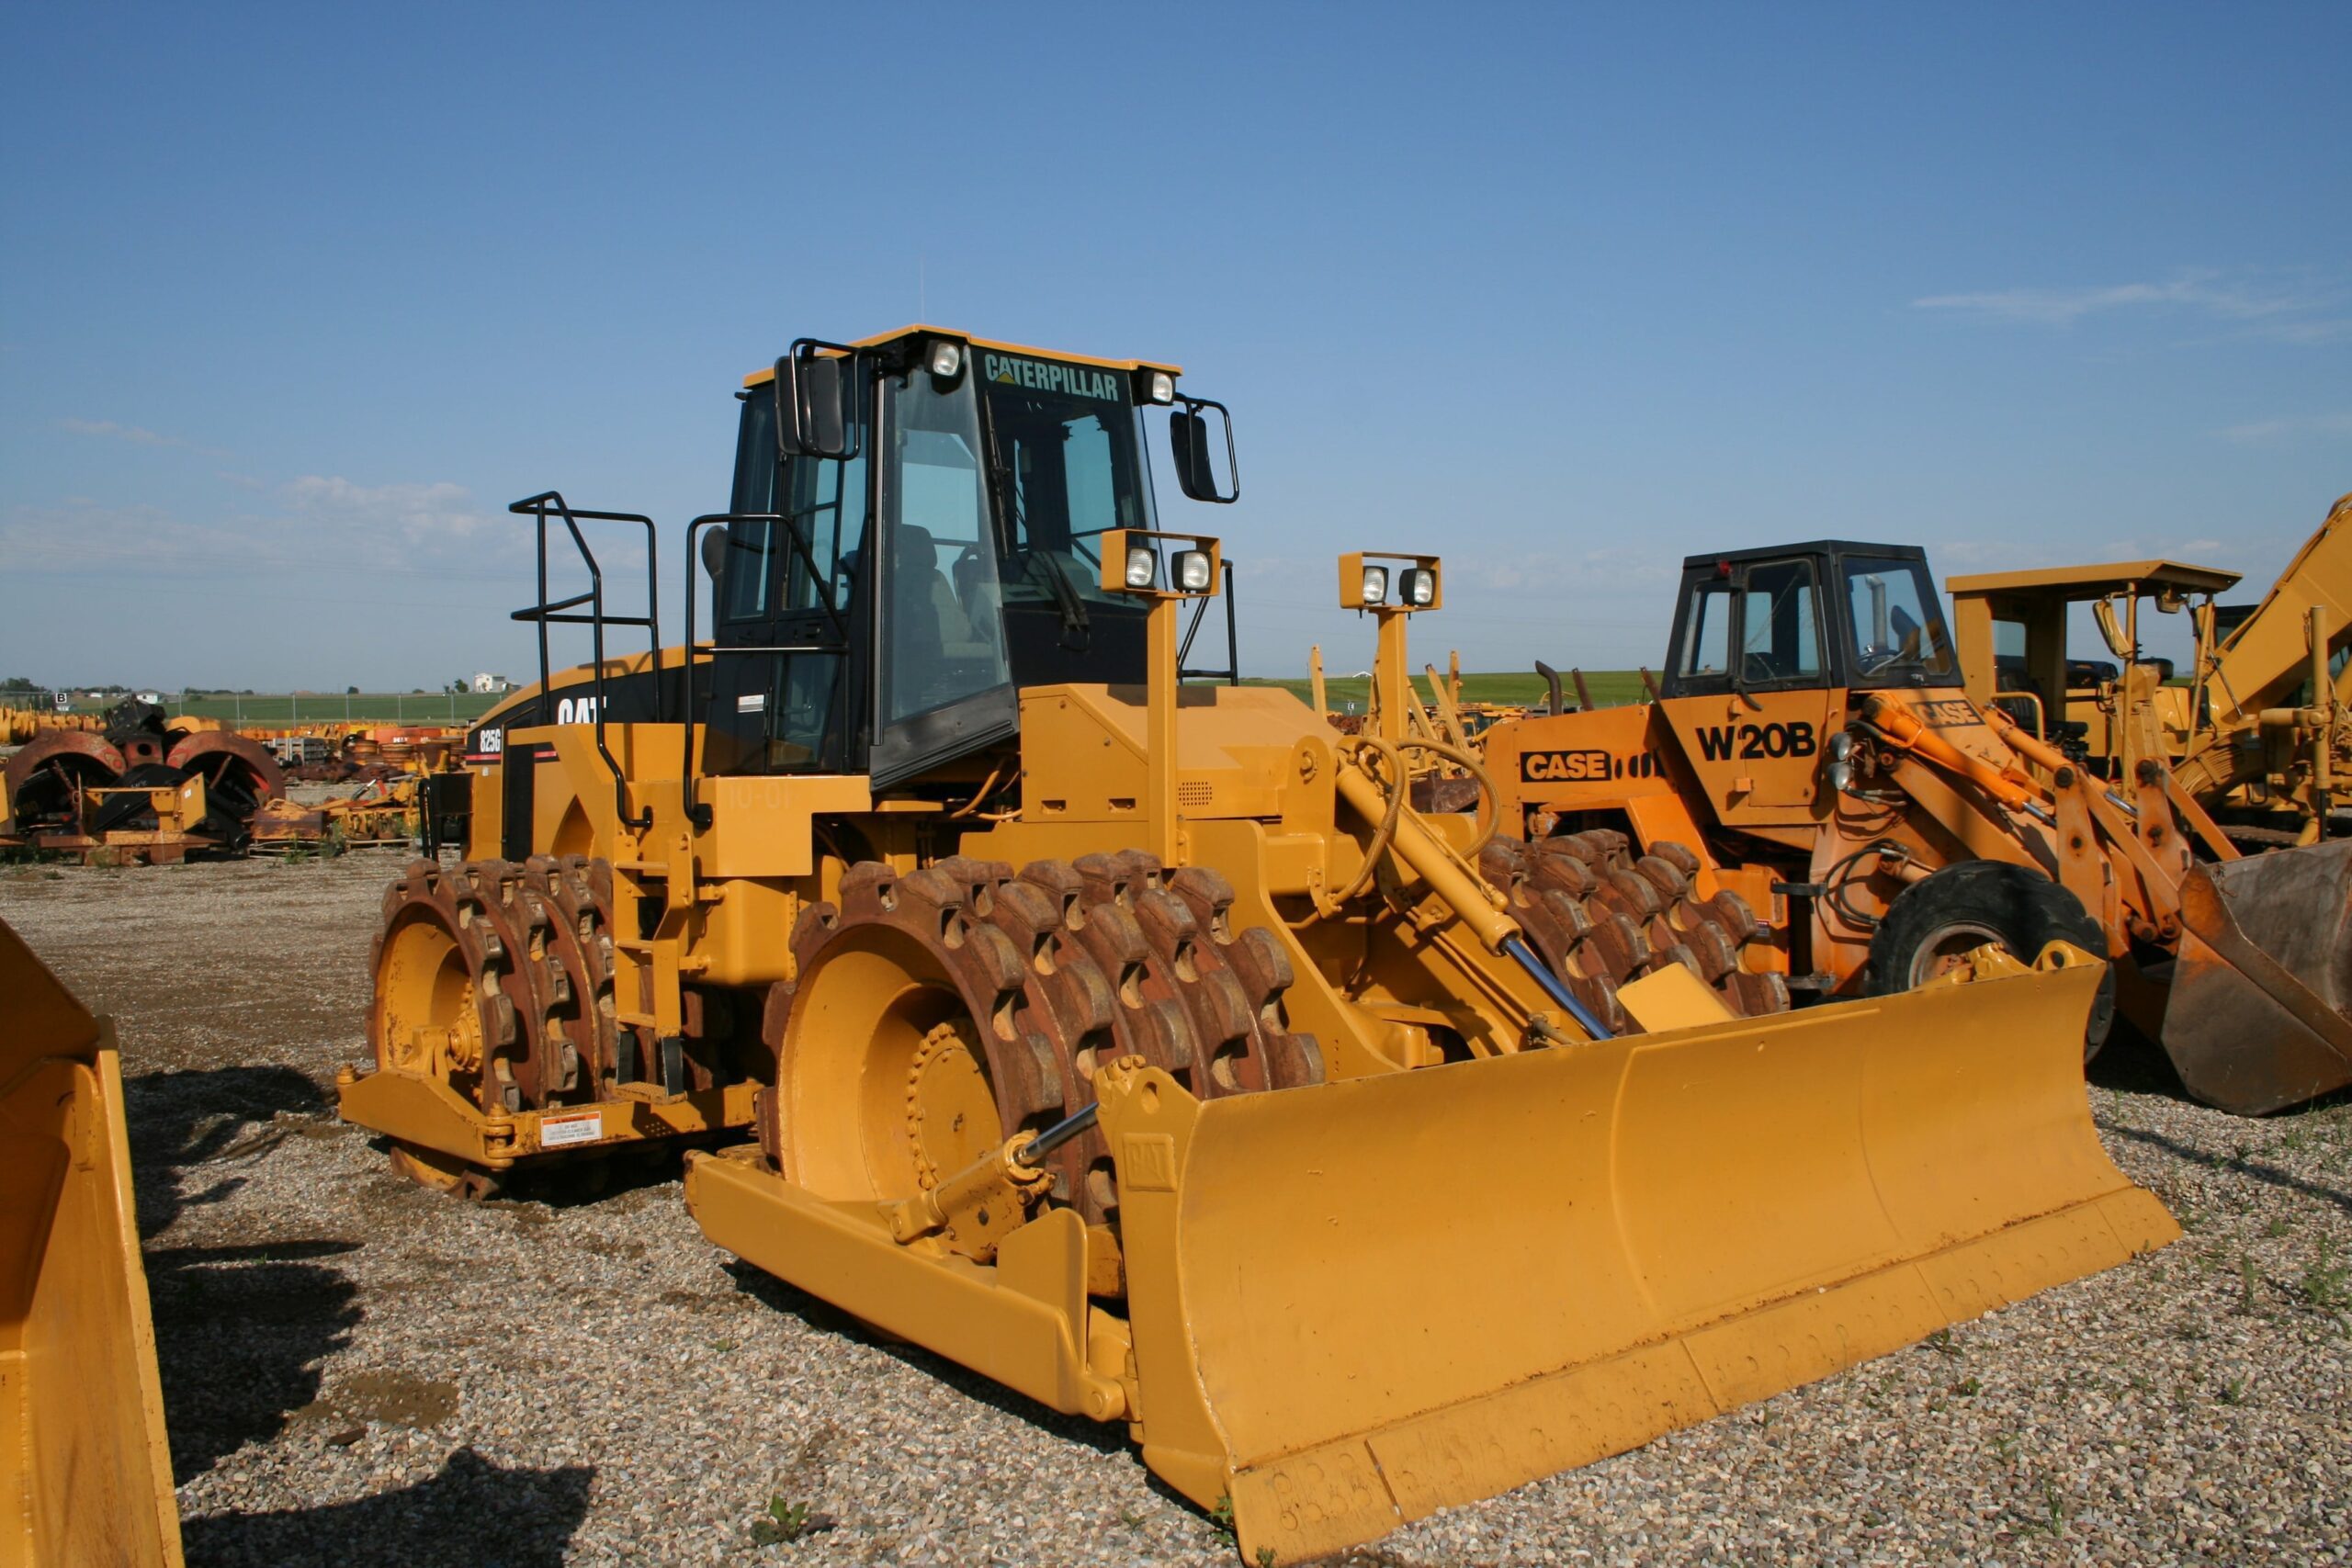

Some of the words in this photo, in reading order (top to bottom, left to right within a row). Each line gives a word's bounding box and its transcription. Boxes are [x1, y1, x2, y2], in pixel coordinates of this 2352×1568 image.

[985, 354, 1119, 401] CATERPILLAR
[57, 694, 65, 703] B
[1914, 702, 1981, 726] CASE
[480, 728, 501, 752] 825G
[1526, 753, 1607, 780] CASE
[1127, 1143, 1166, 1183] CAT
